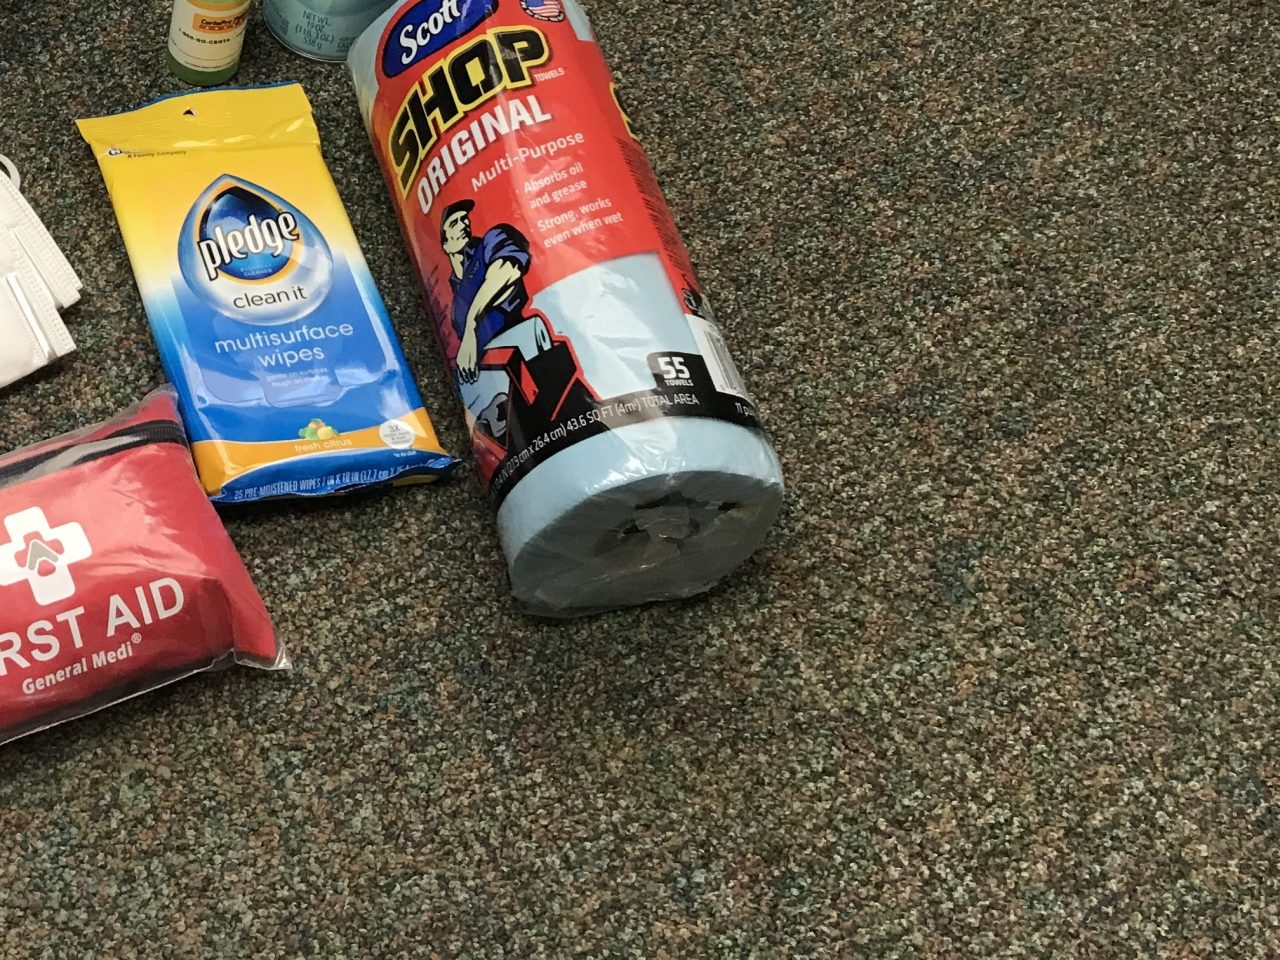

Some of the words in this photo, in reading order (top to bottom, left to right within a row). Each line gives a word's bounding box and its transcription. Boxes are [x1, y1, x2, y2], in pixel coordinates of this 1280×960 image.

[533, 67, 566, 83] TOWELS
[389, 26, 548, 196] SHOP
[417, 94, 553, 216] ORIGINAL
[471, 131, 586, 193] Multi-Purpose
[523, 171, 568, 195] Absorbs
[568, 161, 584, 176] oil
[529, 195, 551, 210] and
[551, 178, 588, 204] grease
[537, 207, 580, 233] Strong,
[578, 197, 613, 216] works
[543, 230, 571, 249] even
[570, 217, 603, 238] when
[601, 210, 624, 226] wet
[198, 212, 300, 281] pledge
[233, 287, 291, 310] clean
[291, 285, 309, 301] it
[214, 322, 354, 354] multisurface
[258, 346, 325, 368] wipes
[658, 356, 691, 380] 55
[663, 378, 695, 388] TOWELS
[388, 424, 401, 433] 3X
[532, 432, 551, 452] 26.4
[549, 422, 568, 442] cm)
[566, 414, 588, 432] 43.6
[586, 408, 601, 424] SQ
[600, 405, 614, 419] FT
[639, 394, 674, 409] TOTAL
[673, 392, 701, 406] AREA
[294, 442, 320, 453] fresh
[323, 438, 353, 450] citrus
[233, 489, 244, 500] 25
[259, 480, 299, 497] MOISTENED
[299, 477, 321, 491] WIPES
[106, 577, 185, 637] AID
[22, 660, 89, 695] General
